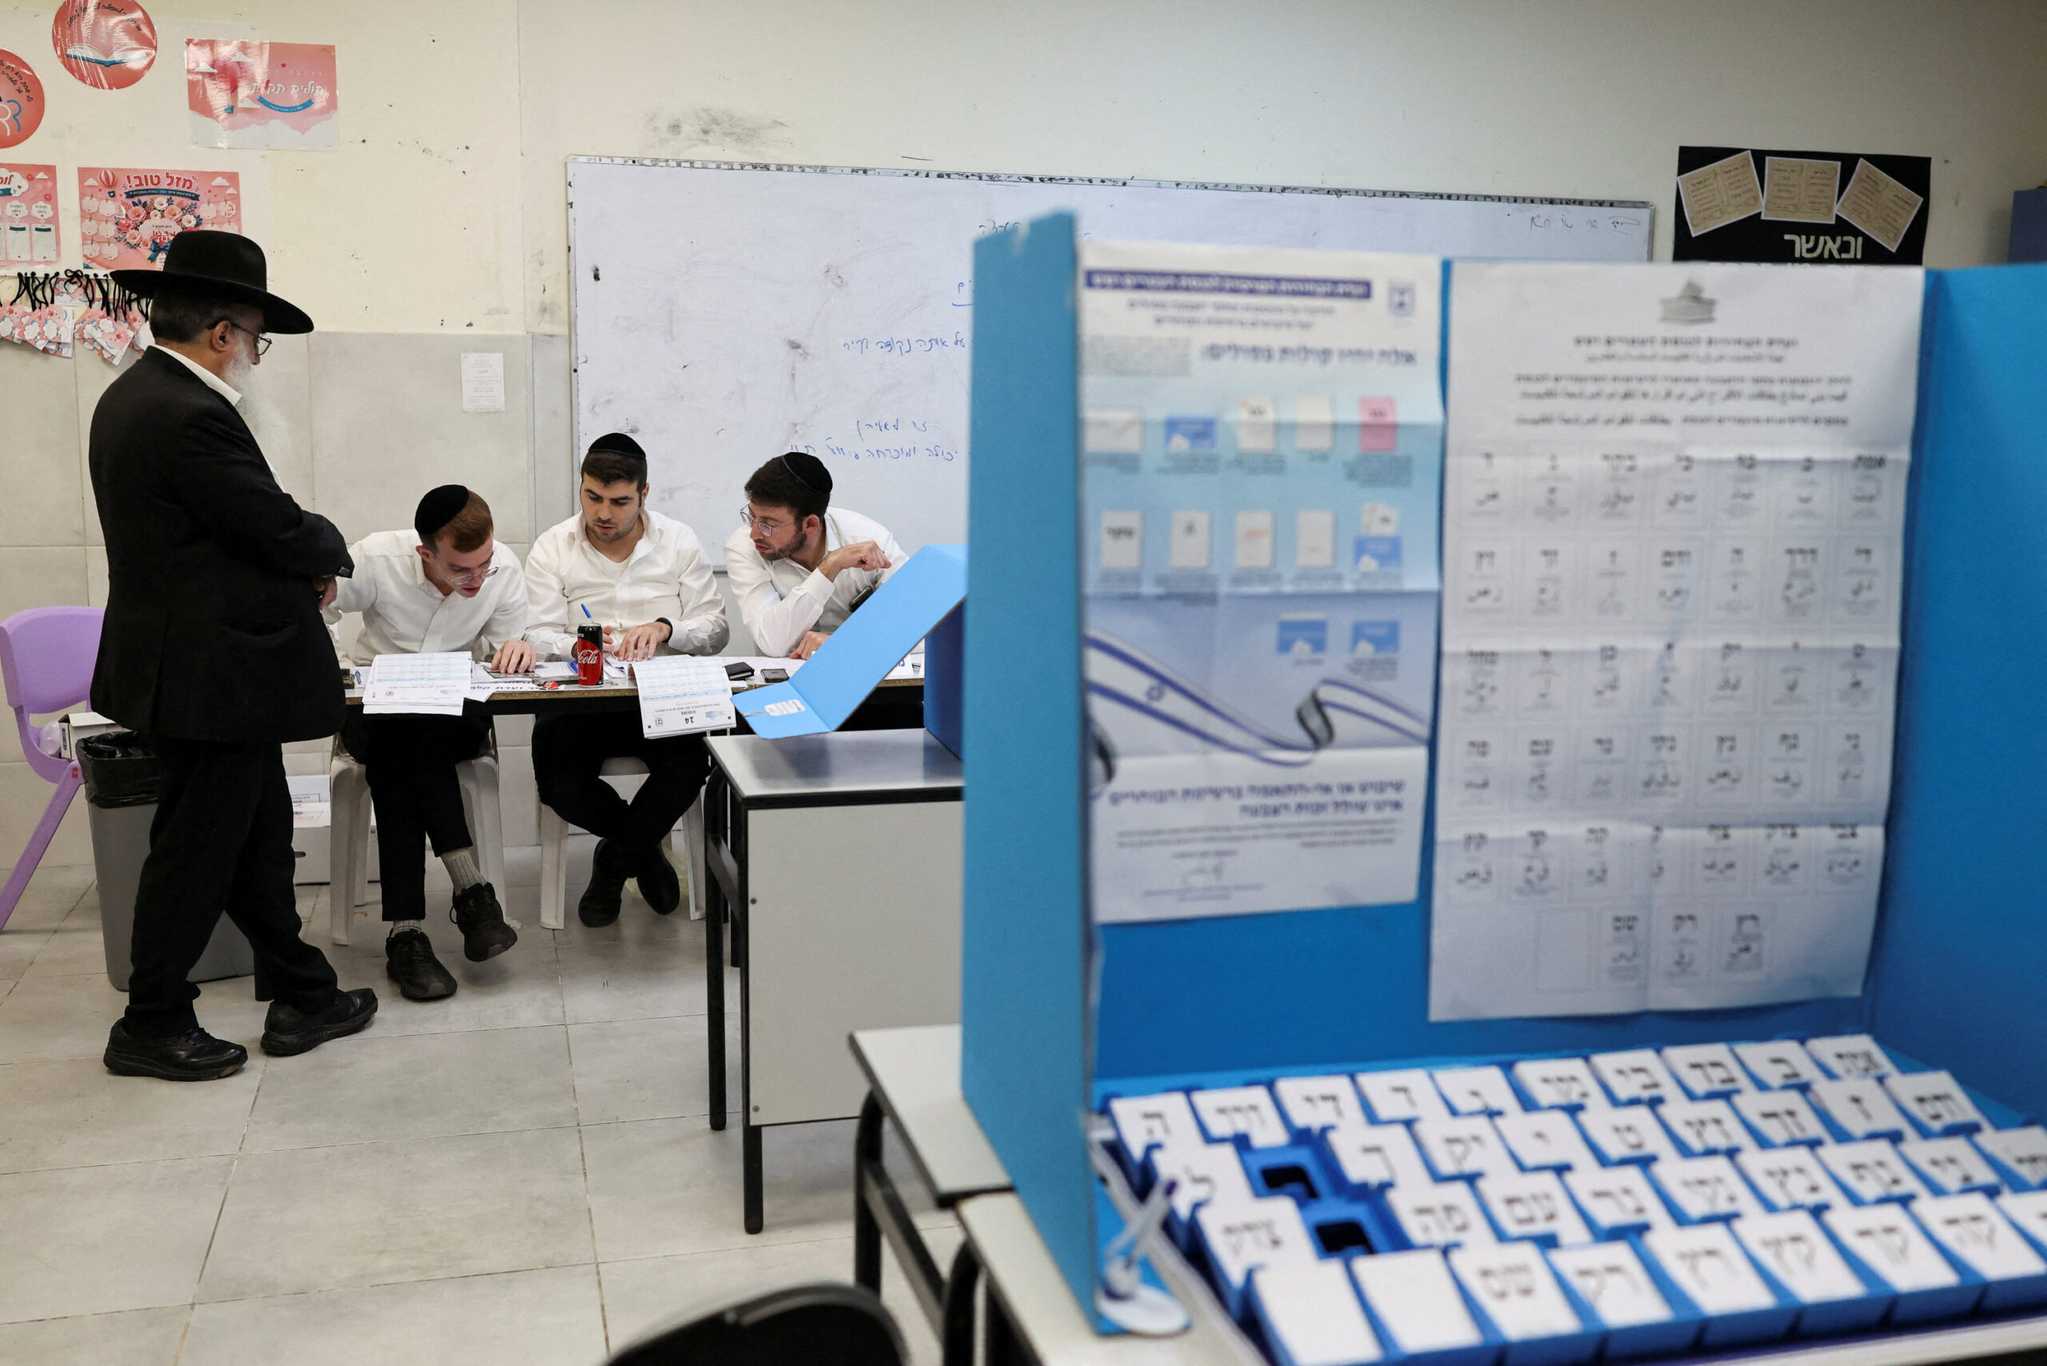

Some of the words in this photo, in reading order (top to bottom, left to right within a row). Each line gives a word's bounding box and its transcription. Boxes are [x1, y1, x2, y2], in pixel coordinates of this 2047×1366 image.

[127, 174, 160, 189] טוב!
[166, 172, 193, 189] מזל
[1783, 233, 1862, 260] וכאשר
[1768, 1057, 1804, 1079] ב
[1849, 1095, 1872, 1120] ז
[1409, 1203, 1471, 1236] פה
[1500, 1193, 1558, 1226] עם
